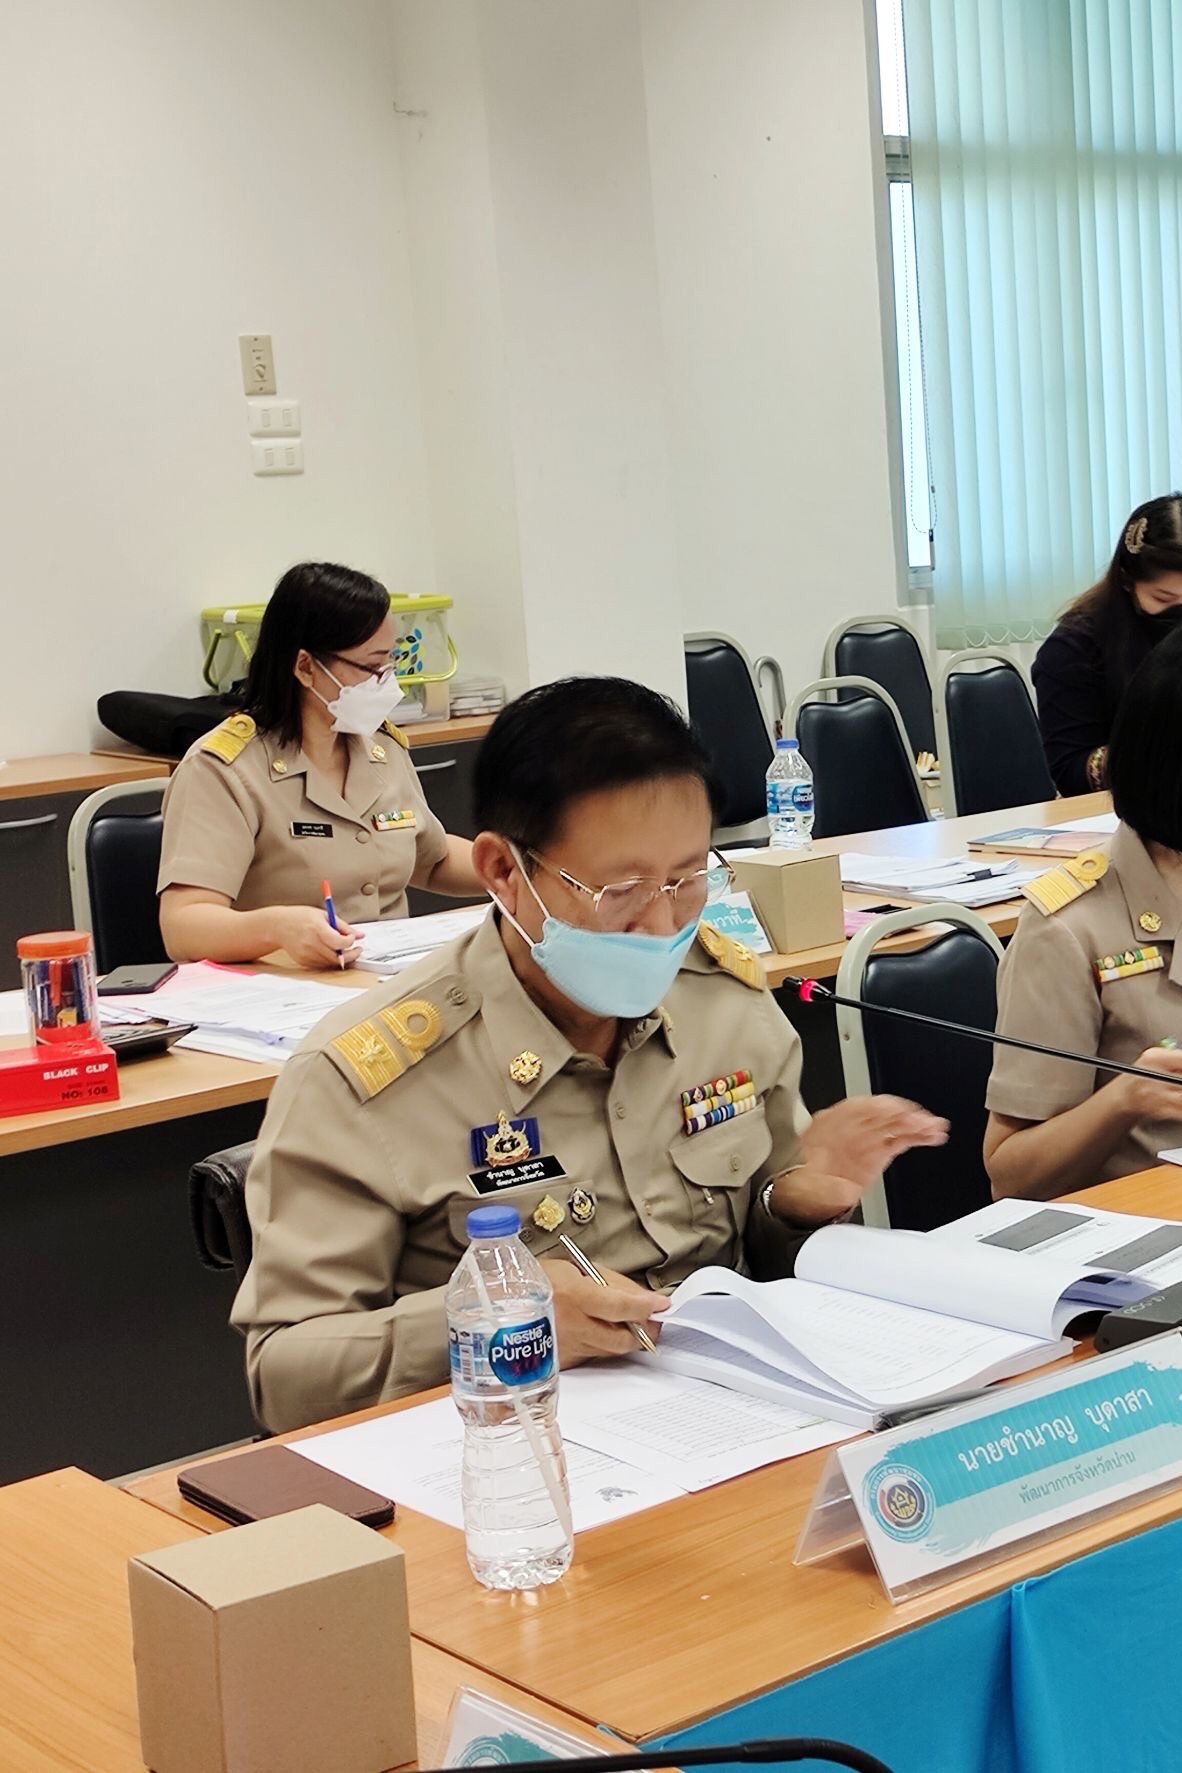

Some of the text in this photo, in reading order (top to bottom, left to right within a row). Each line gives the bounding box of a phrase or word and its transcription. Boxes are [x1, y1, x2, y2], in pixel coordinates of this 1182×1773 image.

[43, 1063, 109, 1080] BLACK CLIP
[491, 1334, 554, 1363] Pure Life
[957, 1386, 1155, 1474] นายชำนาญ บุดาสา
[1018, 1449, 1137, 1505] พัฒนาการจังหวัดน่าน
